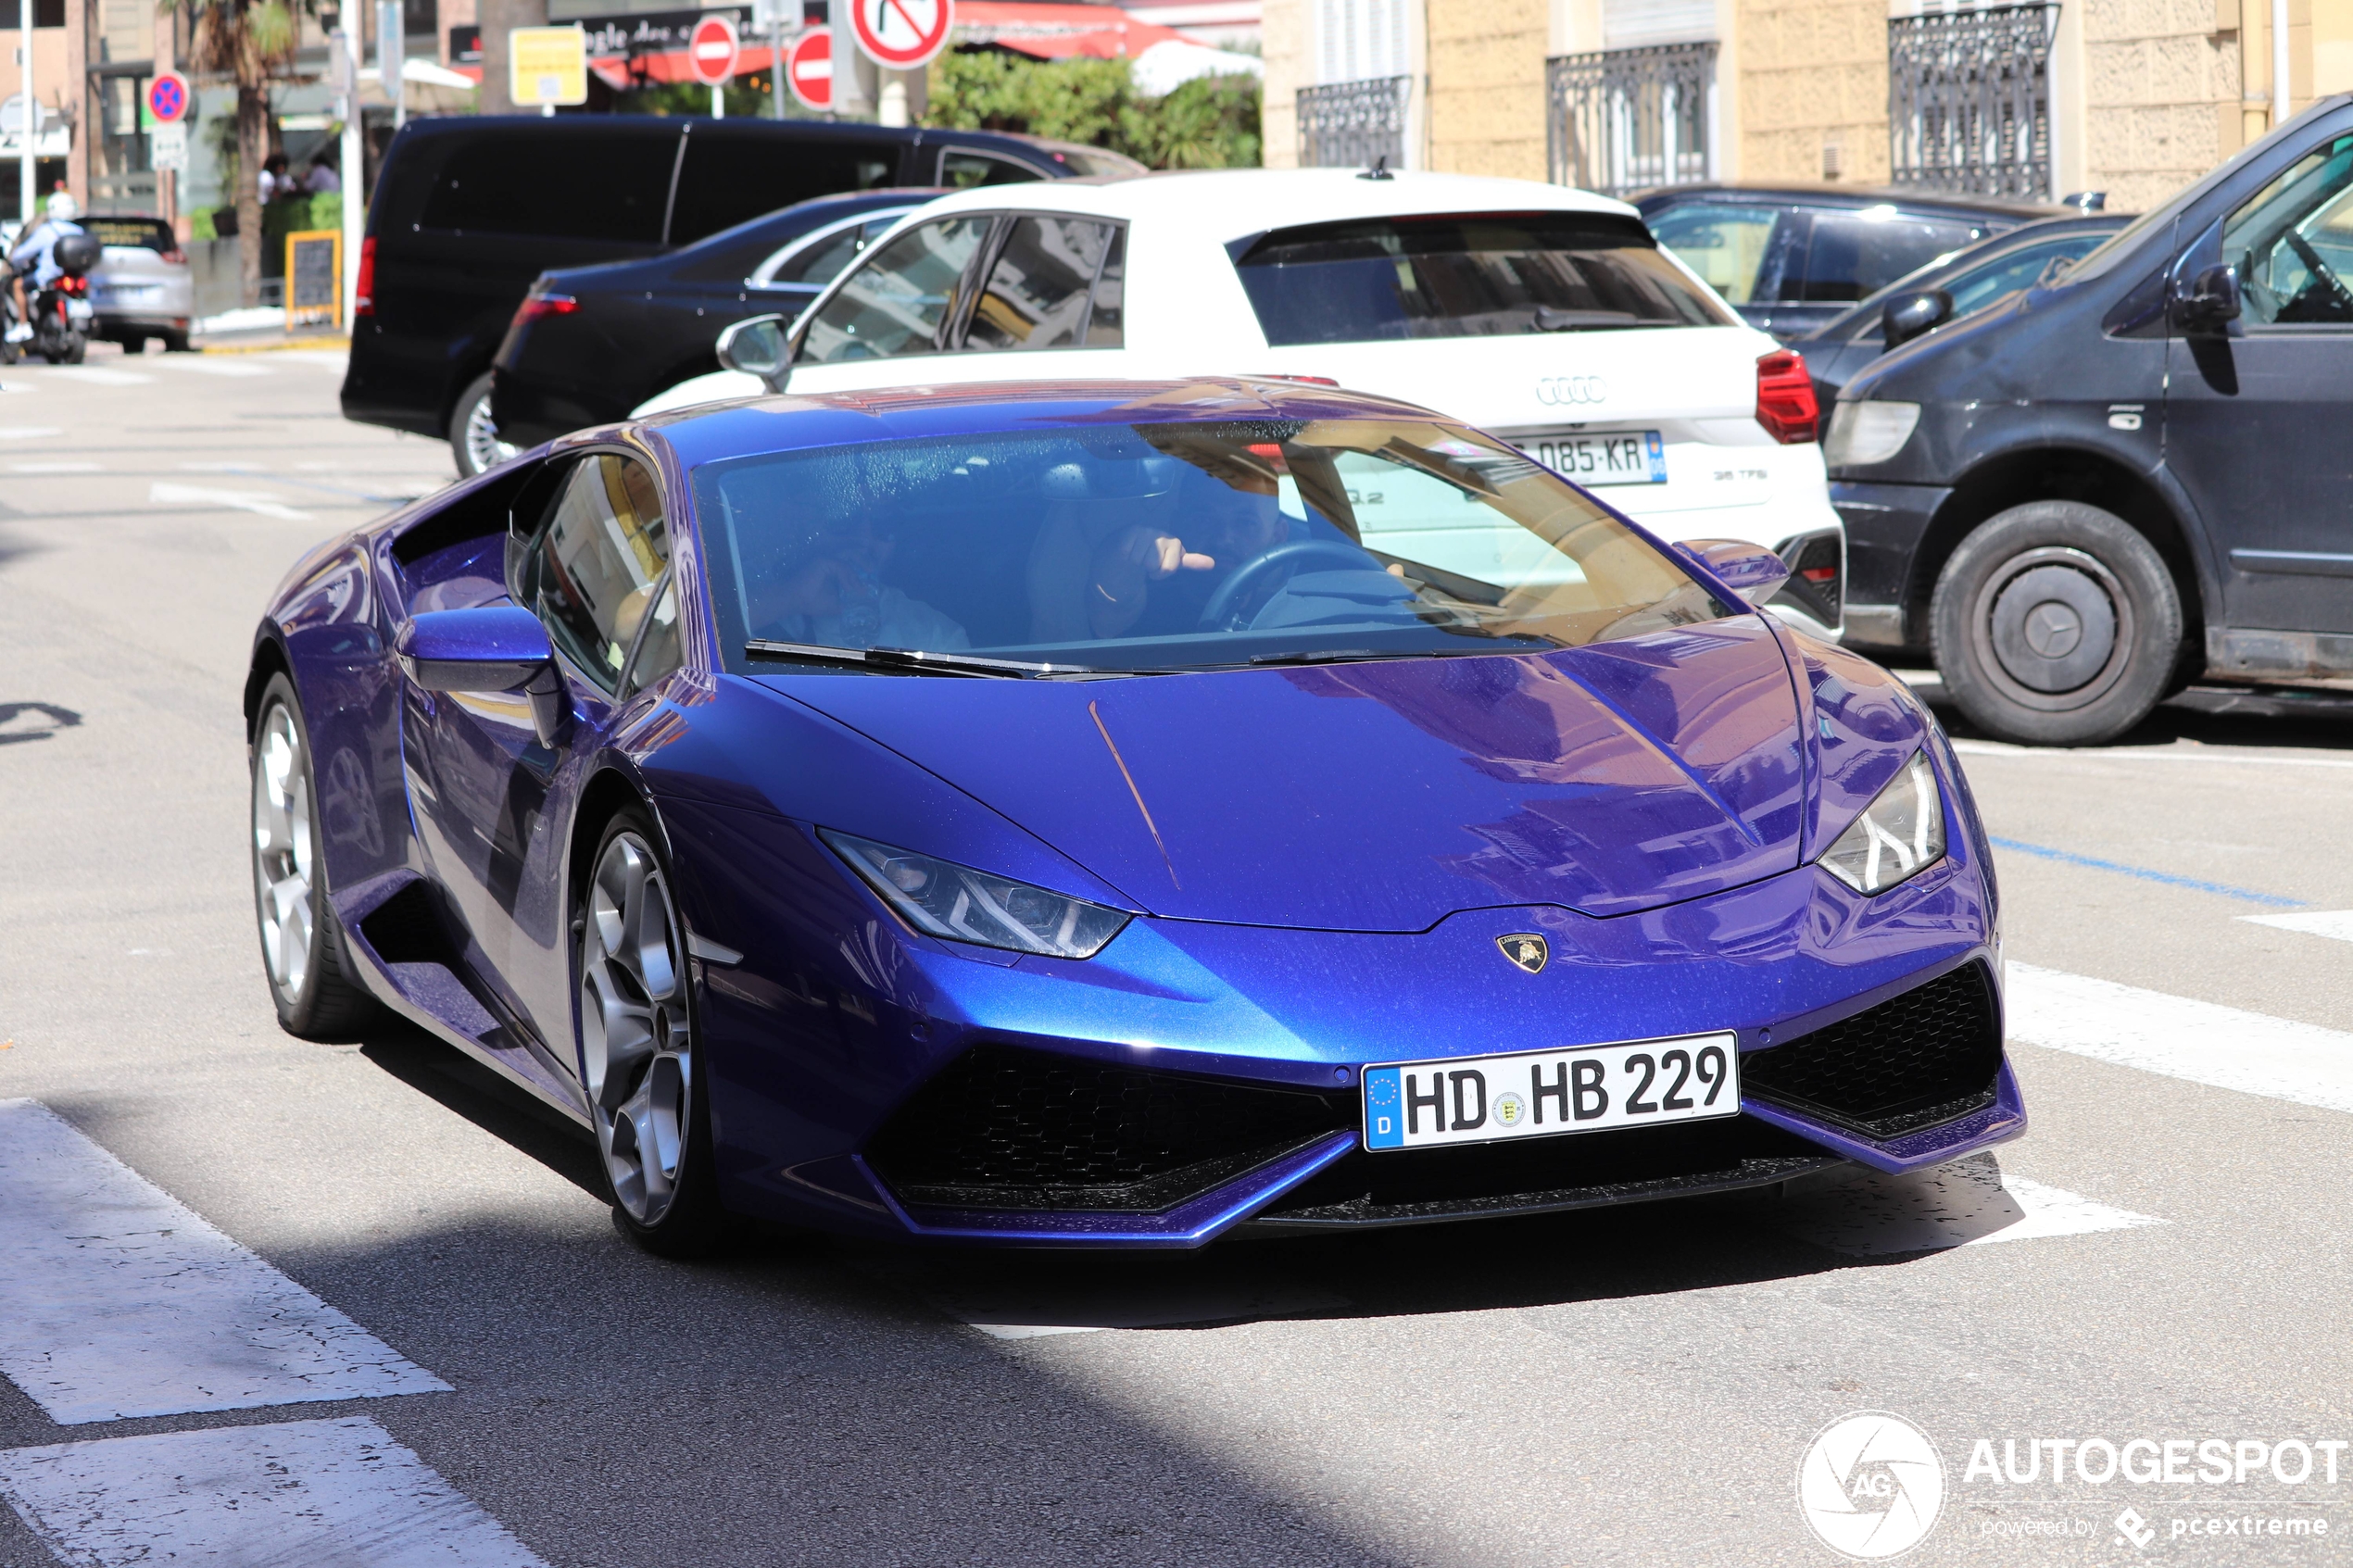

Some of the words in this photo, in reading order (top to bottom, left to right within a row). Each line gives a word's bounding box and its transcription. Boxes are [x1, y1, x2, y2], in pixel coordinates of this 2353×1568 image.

[1514, 438, 1642, 473] 085-KR
[1500, 935, 1542, 945] LAMBORGHINI
[1405, 1069, 1487, 1134] HD
[1531, 1059, 1610, 1124] HB
[1624, 1046, 1728, 1115] 229
[1378, 1116, 1391, 1135] D
